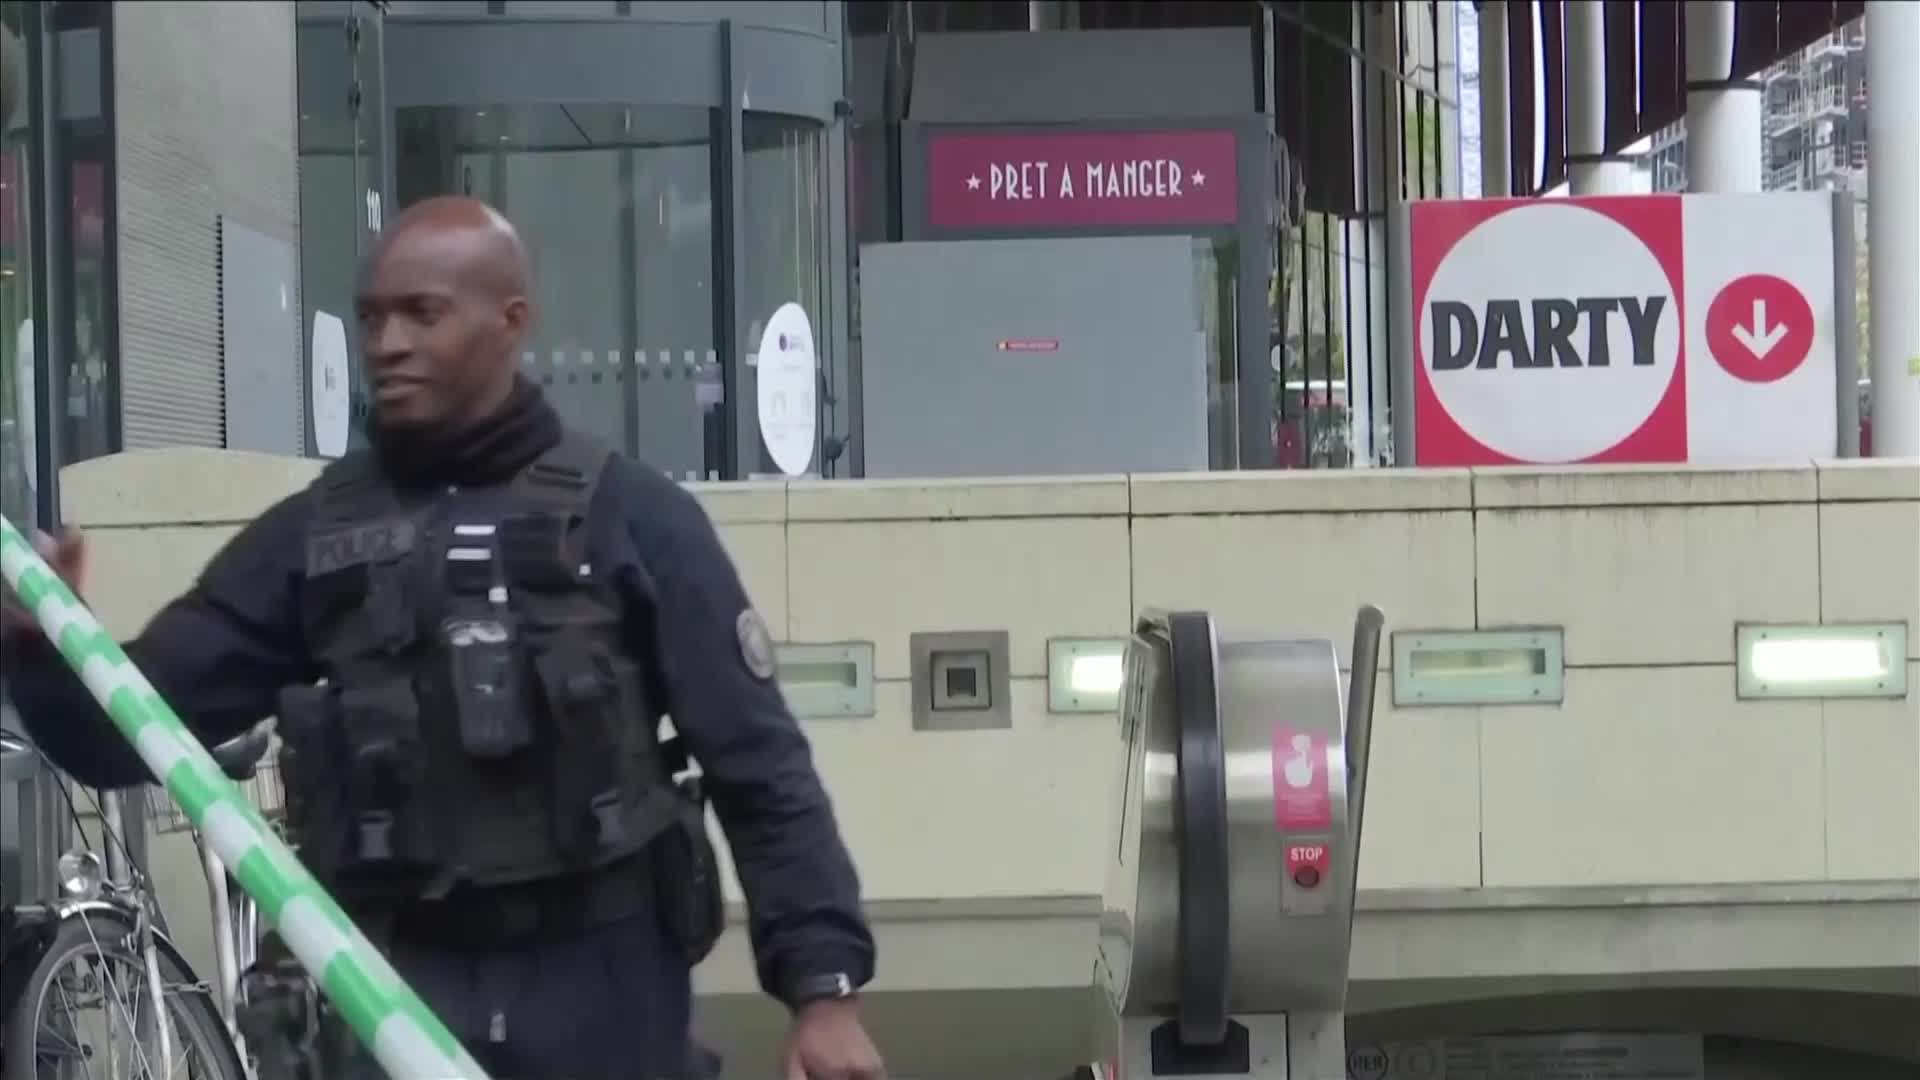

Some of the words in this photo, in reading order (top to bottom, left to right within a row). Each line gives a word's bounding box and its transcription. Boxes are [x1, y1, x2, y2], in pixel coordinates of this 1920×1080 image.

[990, 162, 1048, 200] PRET
[1059, 163, 1075, 199] A
[1087, 159, 1183, 198] MANGER
[1430, 296, 1667, 371] DARTY
[1290, 847, 1323, 861] STOP
